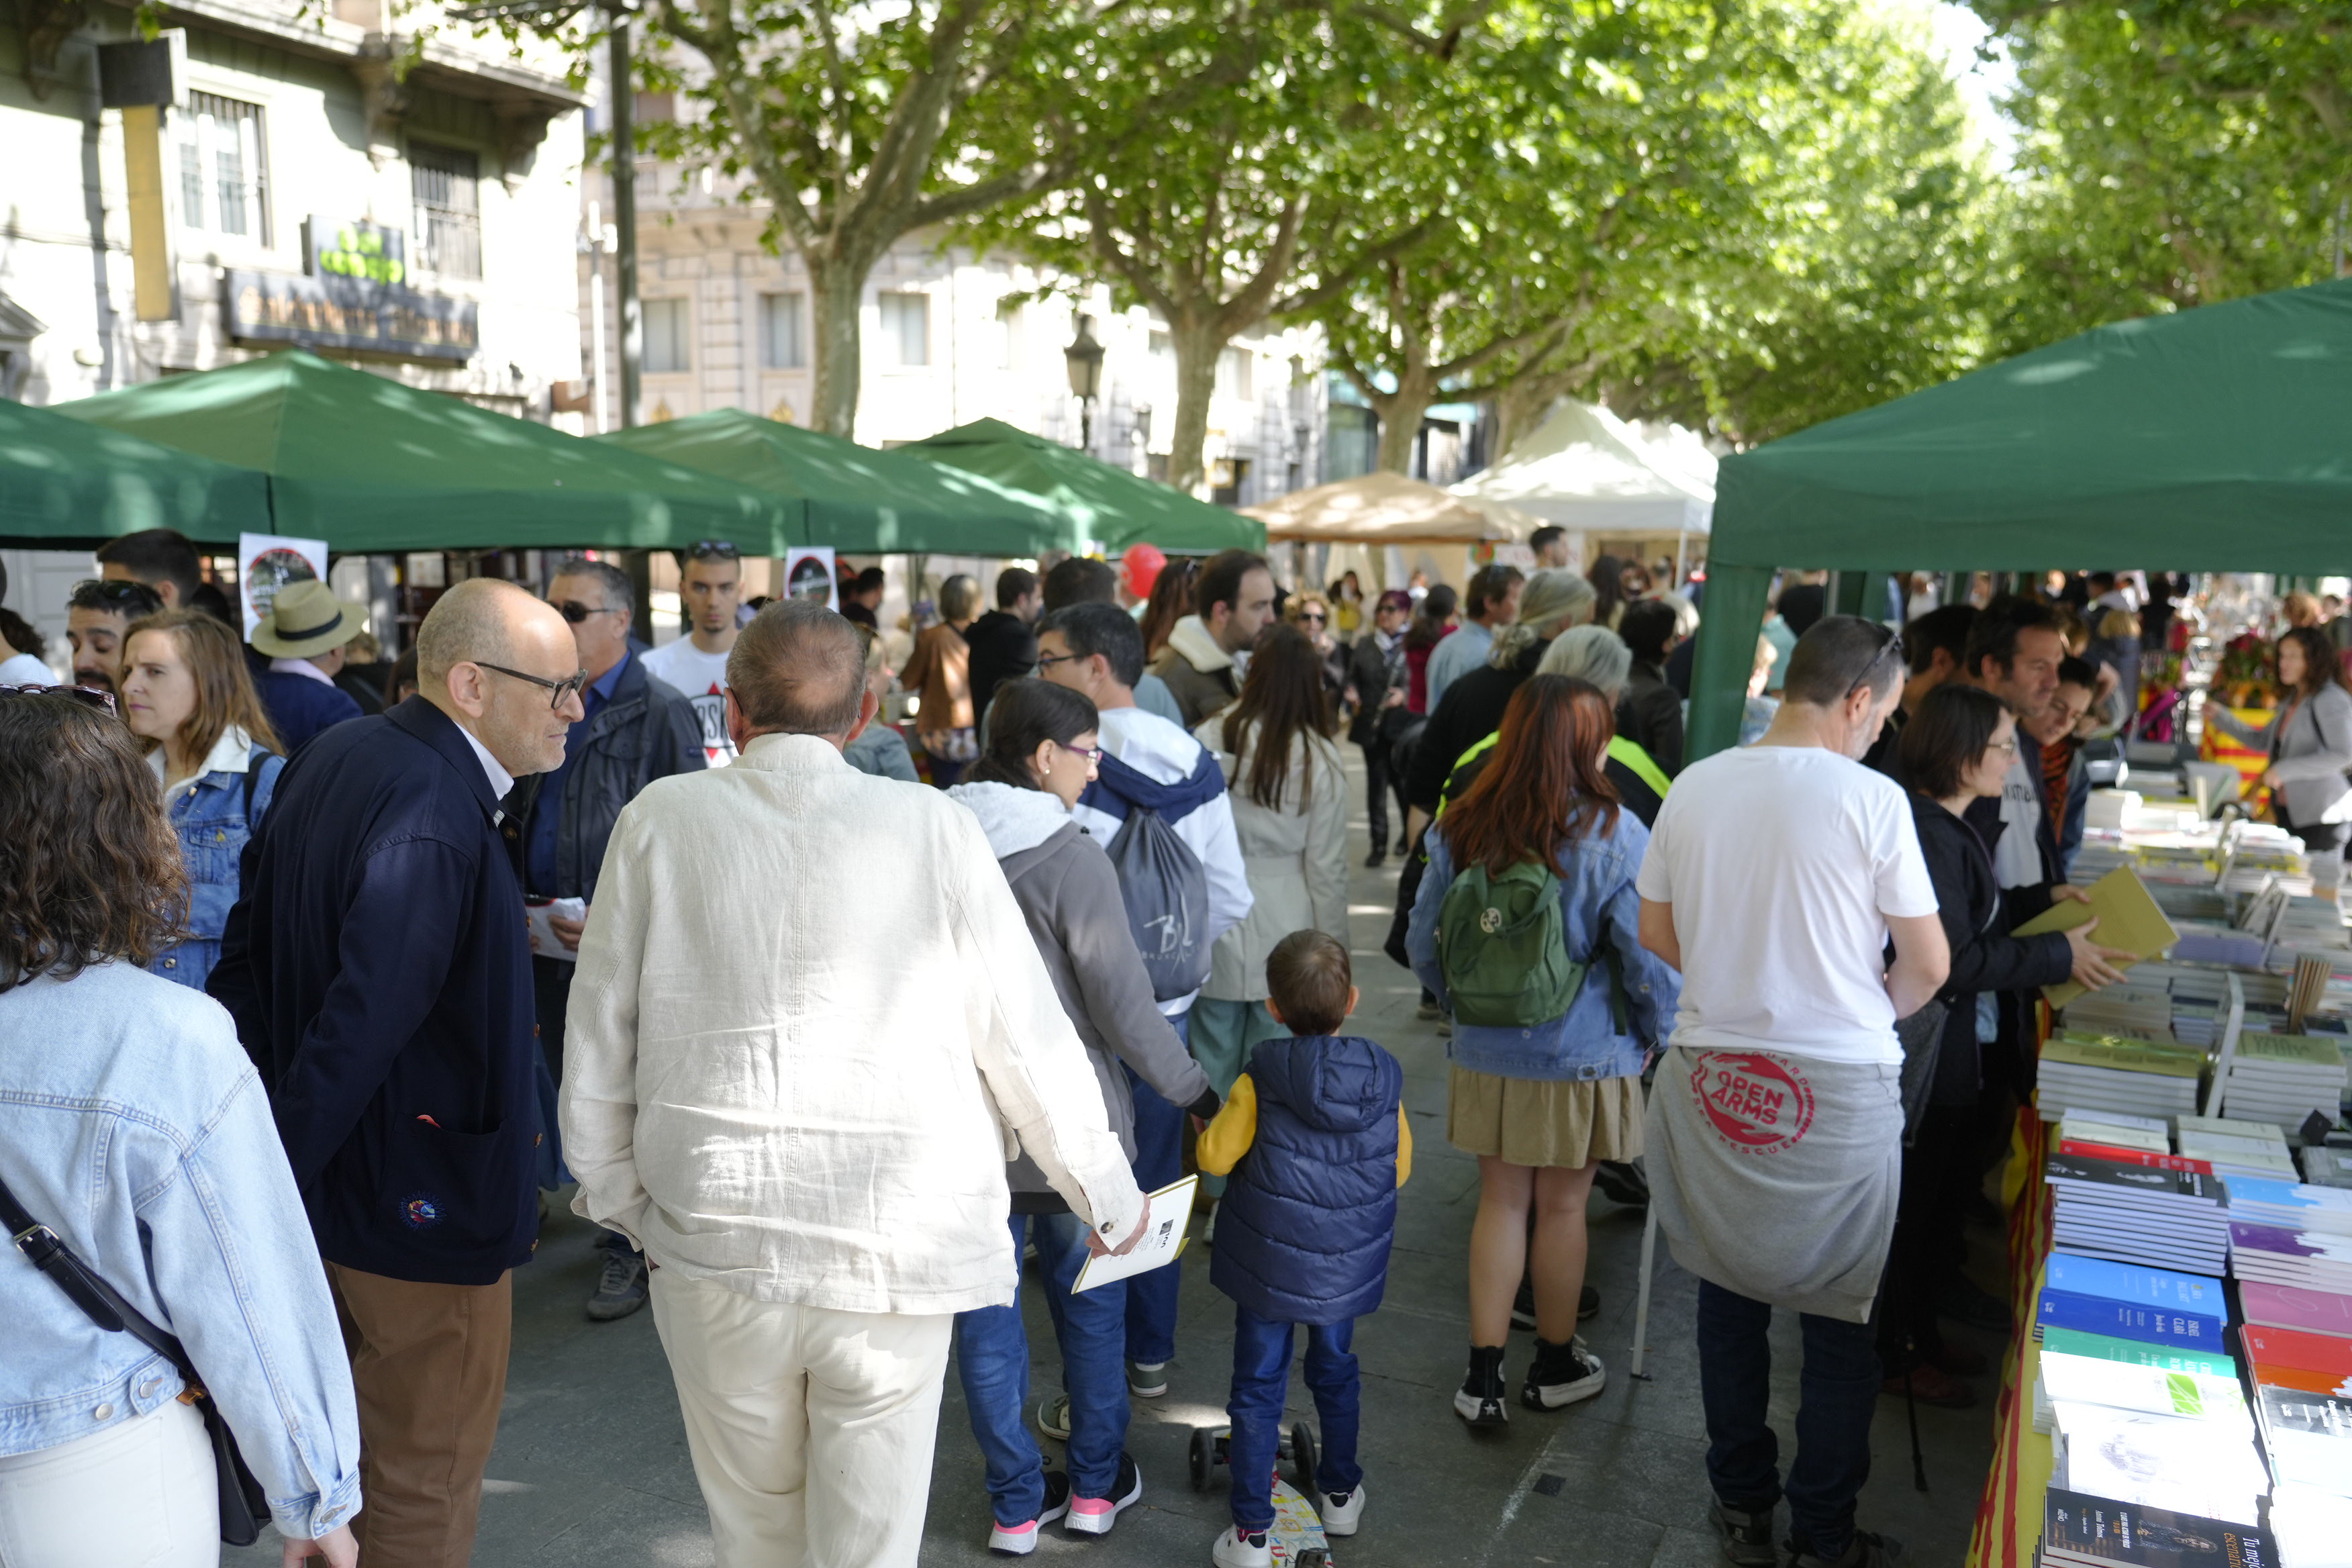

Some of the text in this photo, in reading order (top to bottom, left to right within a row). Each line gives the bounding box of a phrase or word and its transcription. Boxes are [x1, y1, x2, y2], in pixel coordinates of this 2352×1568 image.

[1710, 1087, 1778, 1126] ARMS
[1717, 1071, 1783, 1109] OPEN
[2095, 1510, 2106, 1538] Antoni Tolmos
[2243, 1537, 2260, 1549] Tu
